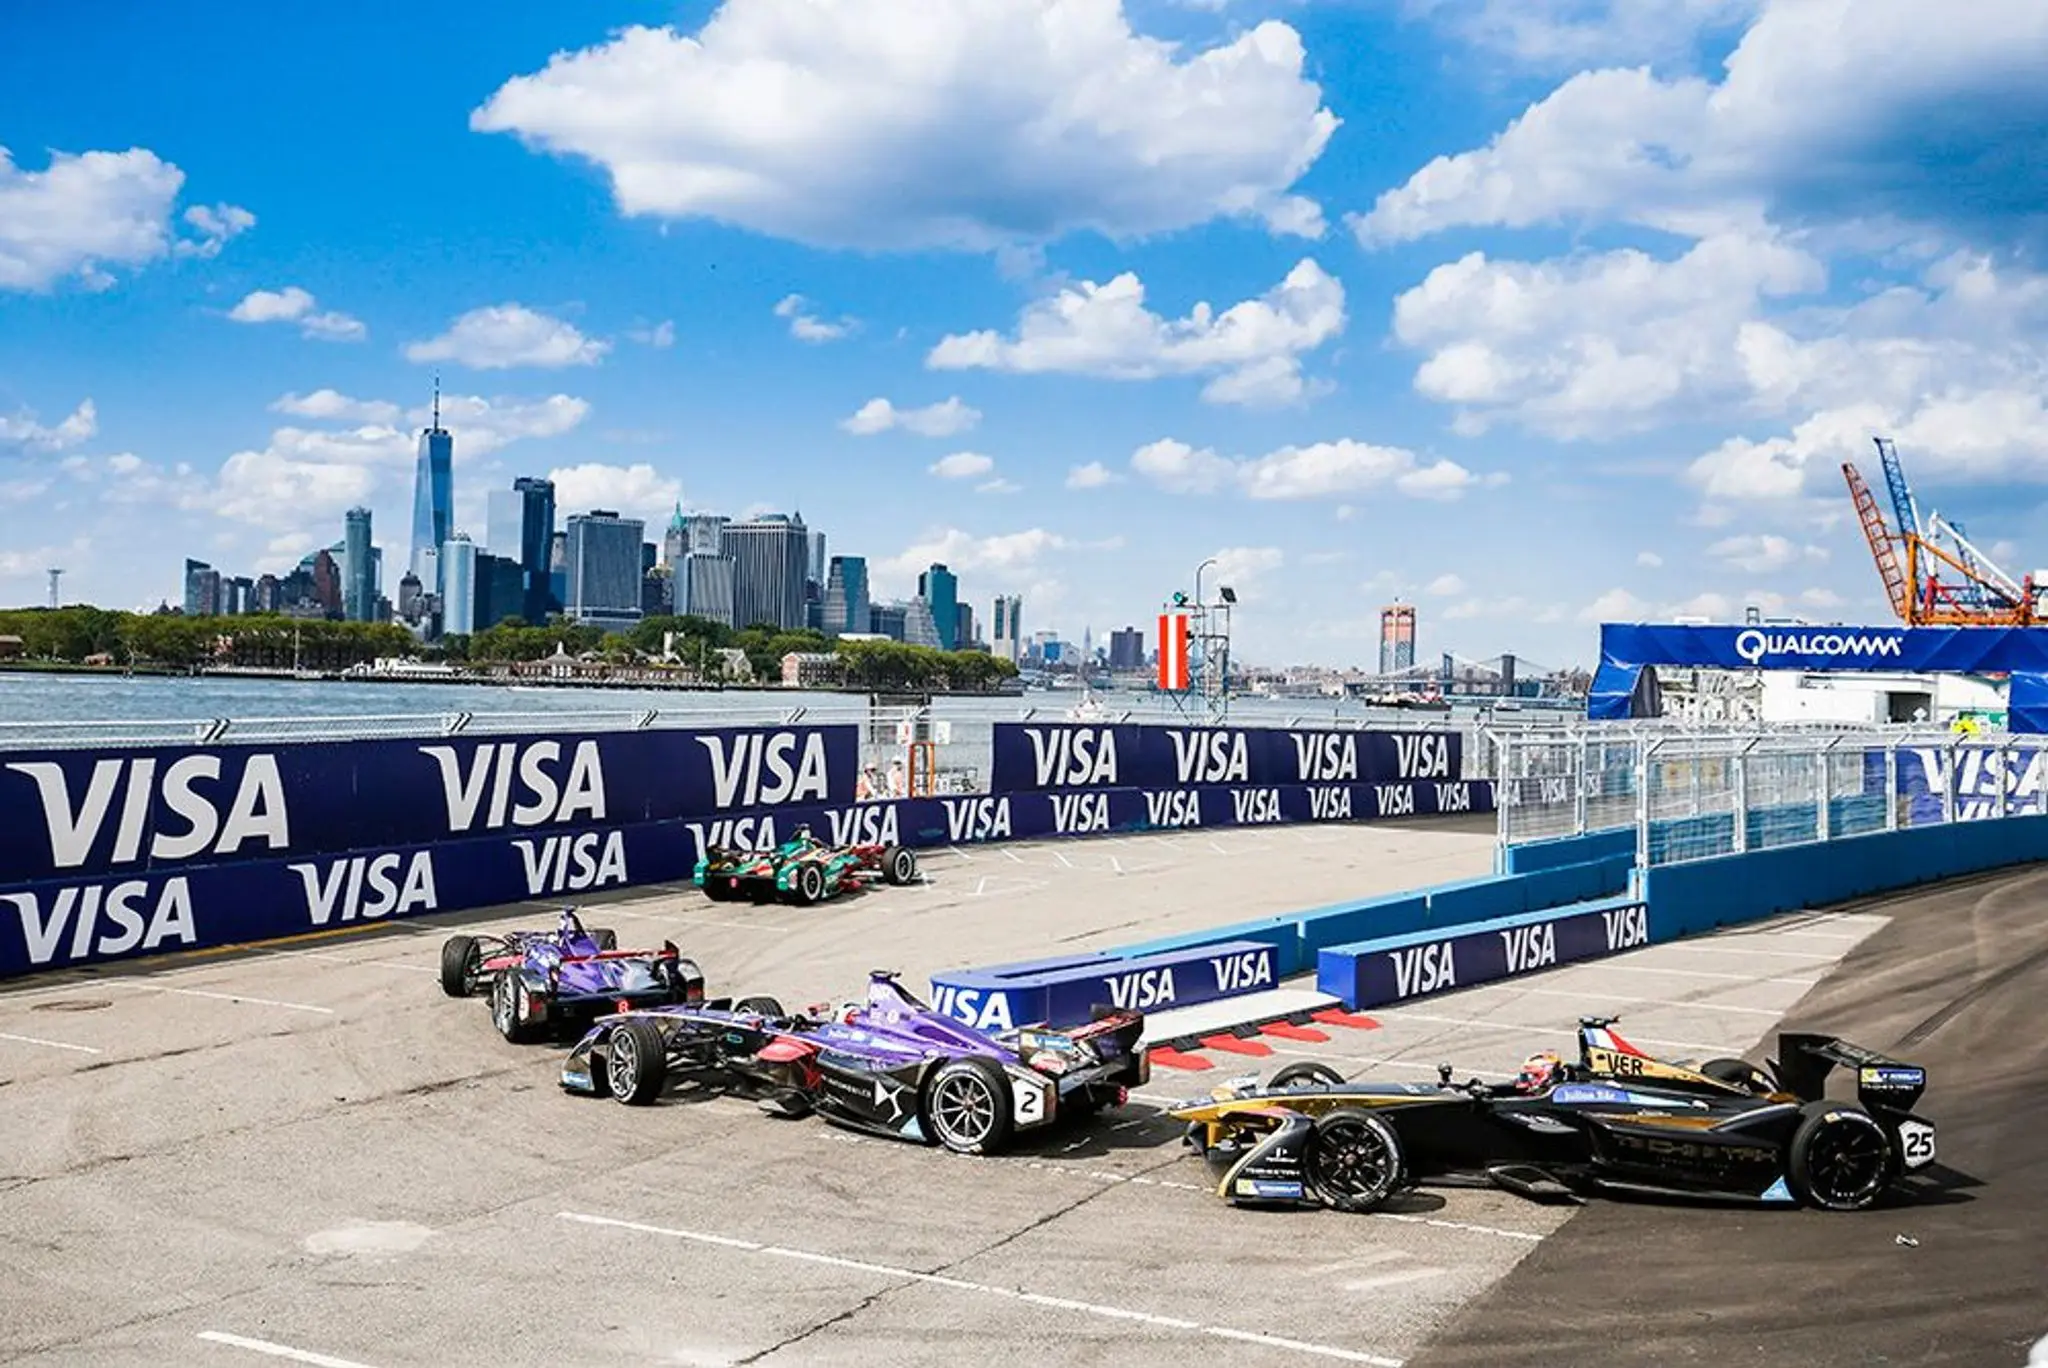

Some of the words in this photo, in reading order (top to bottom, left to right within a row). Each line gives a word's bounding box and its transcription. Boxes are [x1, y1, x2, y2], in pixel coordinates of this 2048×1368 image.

[1735, 630, 1903, 664] QUALCOMM
[695, 732, 827, 808] VISA
[1024, 728, 1117, 786] VISA
[1166, 731, 1248, 782] VISA
[1289, 733, 1357, 780] VISA
[1391, 734, 1448, 778] VISA
[418, 740, 606, 831] VISA
[1230, 788, 1281, 823] VISA
[1306, 786, 1351, 819] VISA
[1374, 784, 1414, 815] VISA
[1434, 782, 1470, 811] VISA
[1488, 780, 1521, 808] VA
[5, 754, 289, 867] VISA
[824, 804, 899, 848] VISA
[941, 797, 1011, 841] VISA
[1048, 793, 1110, 833] VISA
[1142, 790, 1200, 826] VISA
[511, 830, 627, 894] VISA
[287, 850, 437, 925] VISA
[0, 876, 196, 963] VISA
[1602, 906, 1648, 950] VISA
[1501, 922, 1556, 973] VISA
[1103, 968, 1175, 1009] VISA
[1209, 950, 1272, 992] VISA
[1389, 942, 1455, 998] VISA
[930, 979, 1013, 1030] VISA
[1607, 1053, 1643, 1075] VER
[1020, 1091, 1037, 1113] 2
[1907, 1132, 1933, 1157] 25
